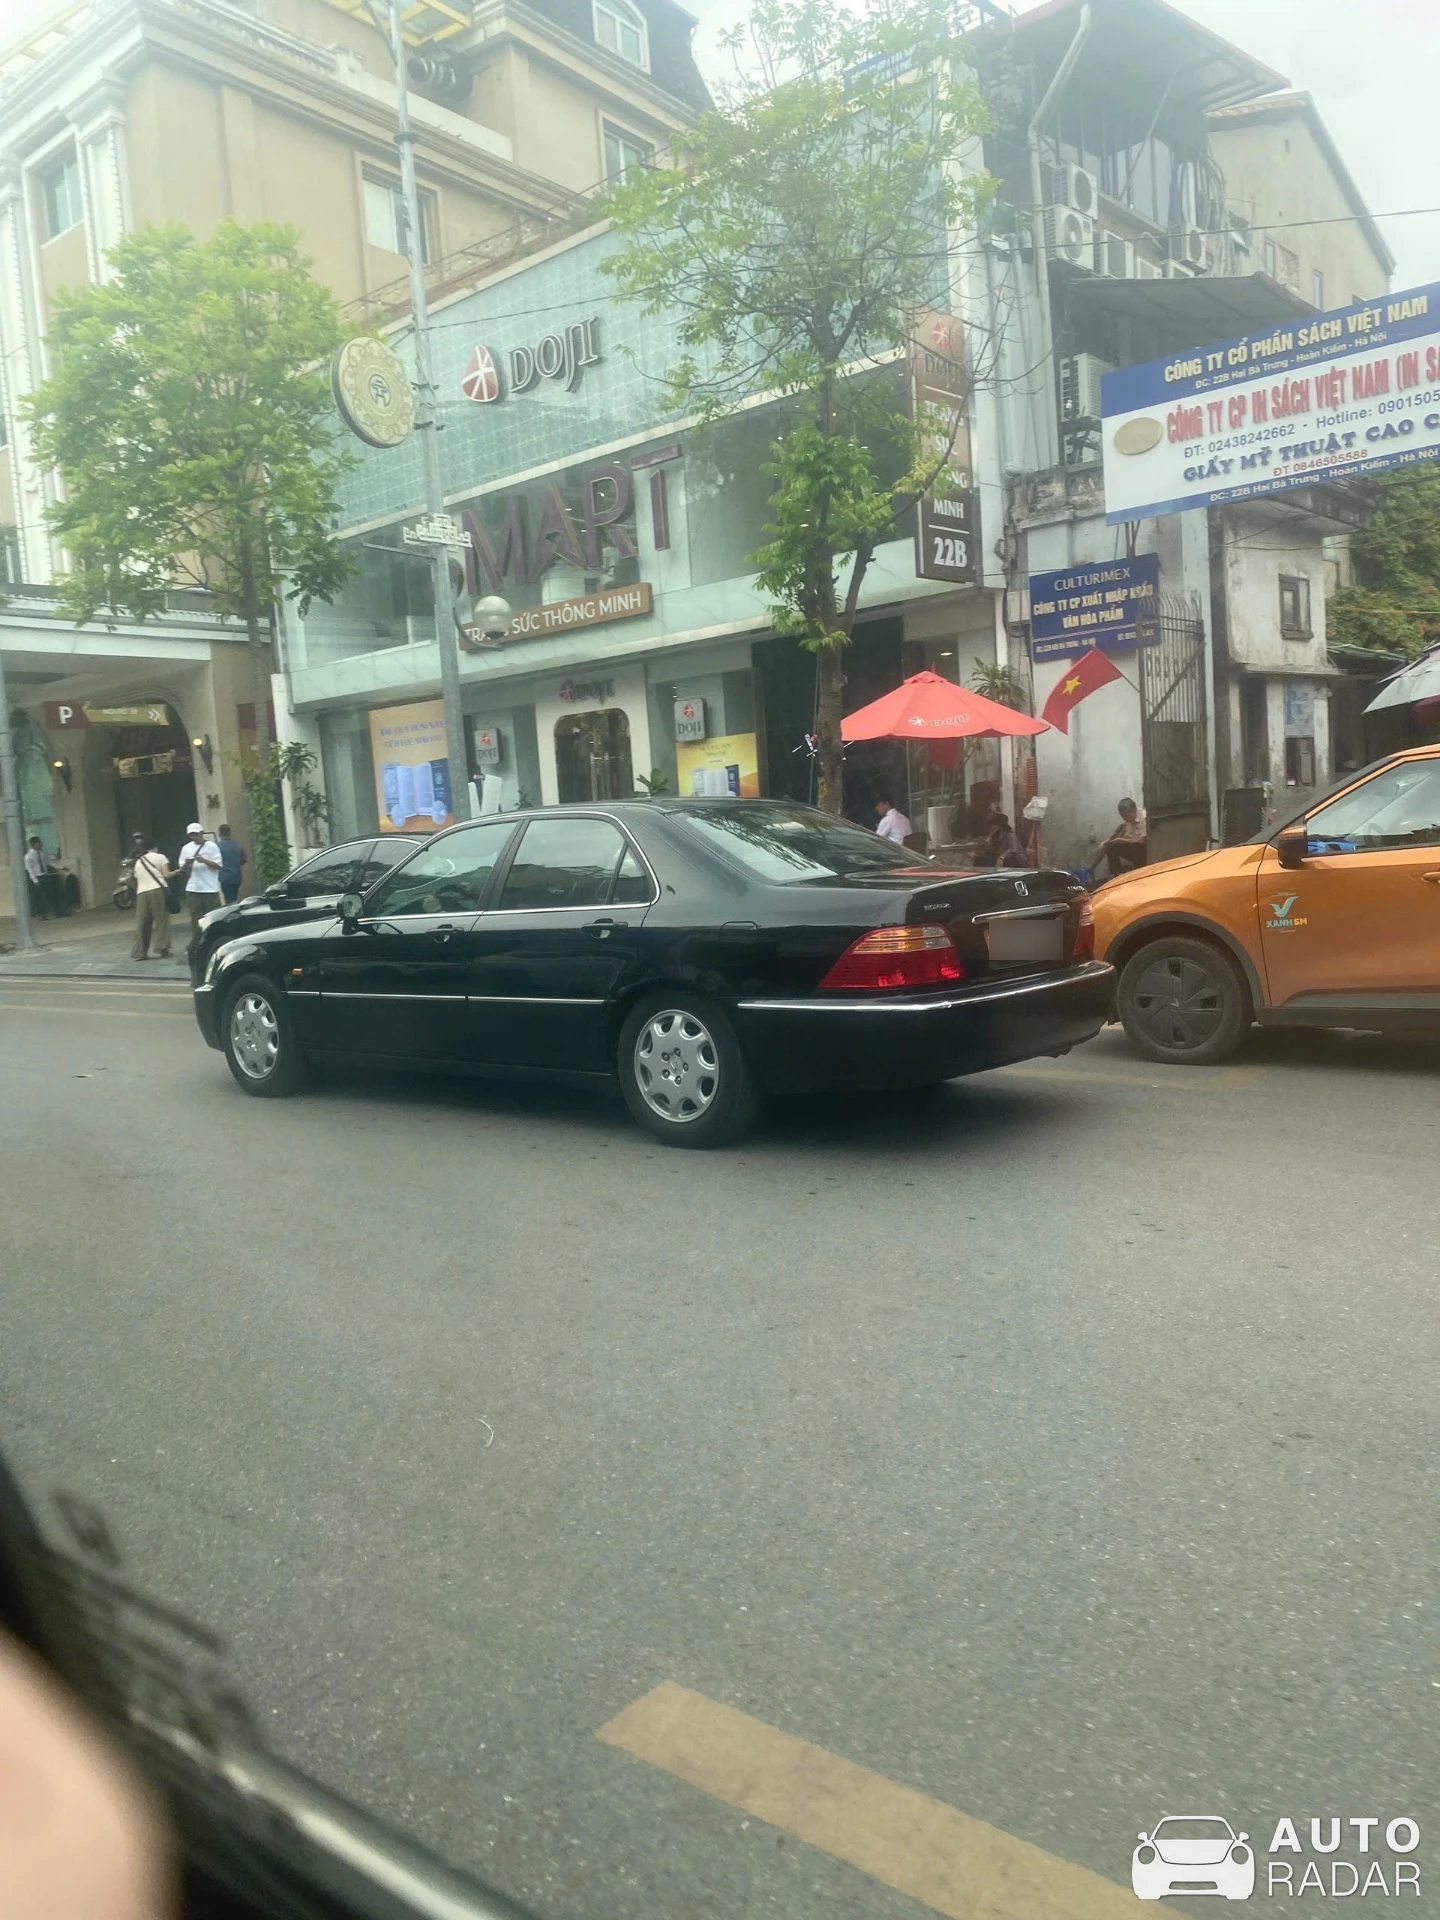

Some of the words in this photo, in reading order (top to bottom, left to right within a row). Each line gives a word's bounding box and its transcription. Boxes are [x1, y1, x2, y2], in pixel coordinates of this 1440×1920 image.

[508, 316, 601, 393] DOJI
[1164, 360, 1202, 382] CÔNG
[1206, 352, 1224, 371] TY
[1227, 337, 1248, 366] CỔ
[1252, 329, 1293, 359] PHẦN
[1298, 319, 1342, 347] SÁCH
[1347, 307, 1382, 333] VIỆT
[1387, 295, 1428, 323] NAM
[1213, 374, 1230, 384] 22B
[1231, 369, 1246, 380] Hai
[1248, 364, 1260, 375] Bà
[1296, 350, 1321, 361] Hoàn
[1322, 343, 1347, 356] Kiếm
[1354, 337, 1368, 347] Hà
[1370, 332, 1387, 343] Nội
[1166, 404, 1203, 444] CÔNG
[1207, 400, 1223, 434] TY
[1252, 389, 1268, 425] IN
[1271, 377, 1310, 420] SÁCH
[1314, 366, 1347, 412] VIỆT
[1352, 358, 1390, 400] NAM
[1396, 351, 1420, 392] (IN
[1426, 345, 1440, 383] S
[1184, 444, 1205, 458] ĐT:
[1208, 423, 1295, 453] 02438242662
[1316, 409, 1372, 429] Hotline:
[1378, 389, 1440, 415] 0901505
[1183, 455, 1234, 482] GIẤY
[1240, 446, 1273, 470] MỸ
[1278, 431, 1357, 461] THUẬT
[1365, 419, 1415, 442] CAO
[1293, 449, 1368, 472] 0846505588
[1231, 488, 1250, 498] 22B
[1253, 483, 1270, 493] Hai
[1272, 479, 1286, 489] Bà
[1329, 466, 1358, 477] Hoàn
[1360, 459, 1390, 471] Kiếm
[1400, 454, 1416, 463] Hà
[1418, 448, 1438, 459] Nội
[933, 498, 965, 519] MINH
[933, 536, 967, 568] 22B
[1054, 567, 1131, 591] CULTURIMEX
[511, 611, 540, 634] SỨC
[543, 602, 595, 628] THÔNG
[599, 591, 641, 616] MINH
[1033, 601, 1056, 616] CÔNG
[1058, 599, 1068, 611] TY
[1069, 597, 1081, 609] CP
[1082, 590, 1103, 607] XUẤT
[59, 706, 73, 724] P
[677, 721, 702, 736] DOJI
[1266, 919, 1293, 928] XANH
[1293, 917, 1308, 926] SM
